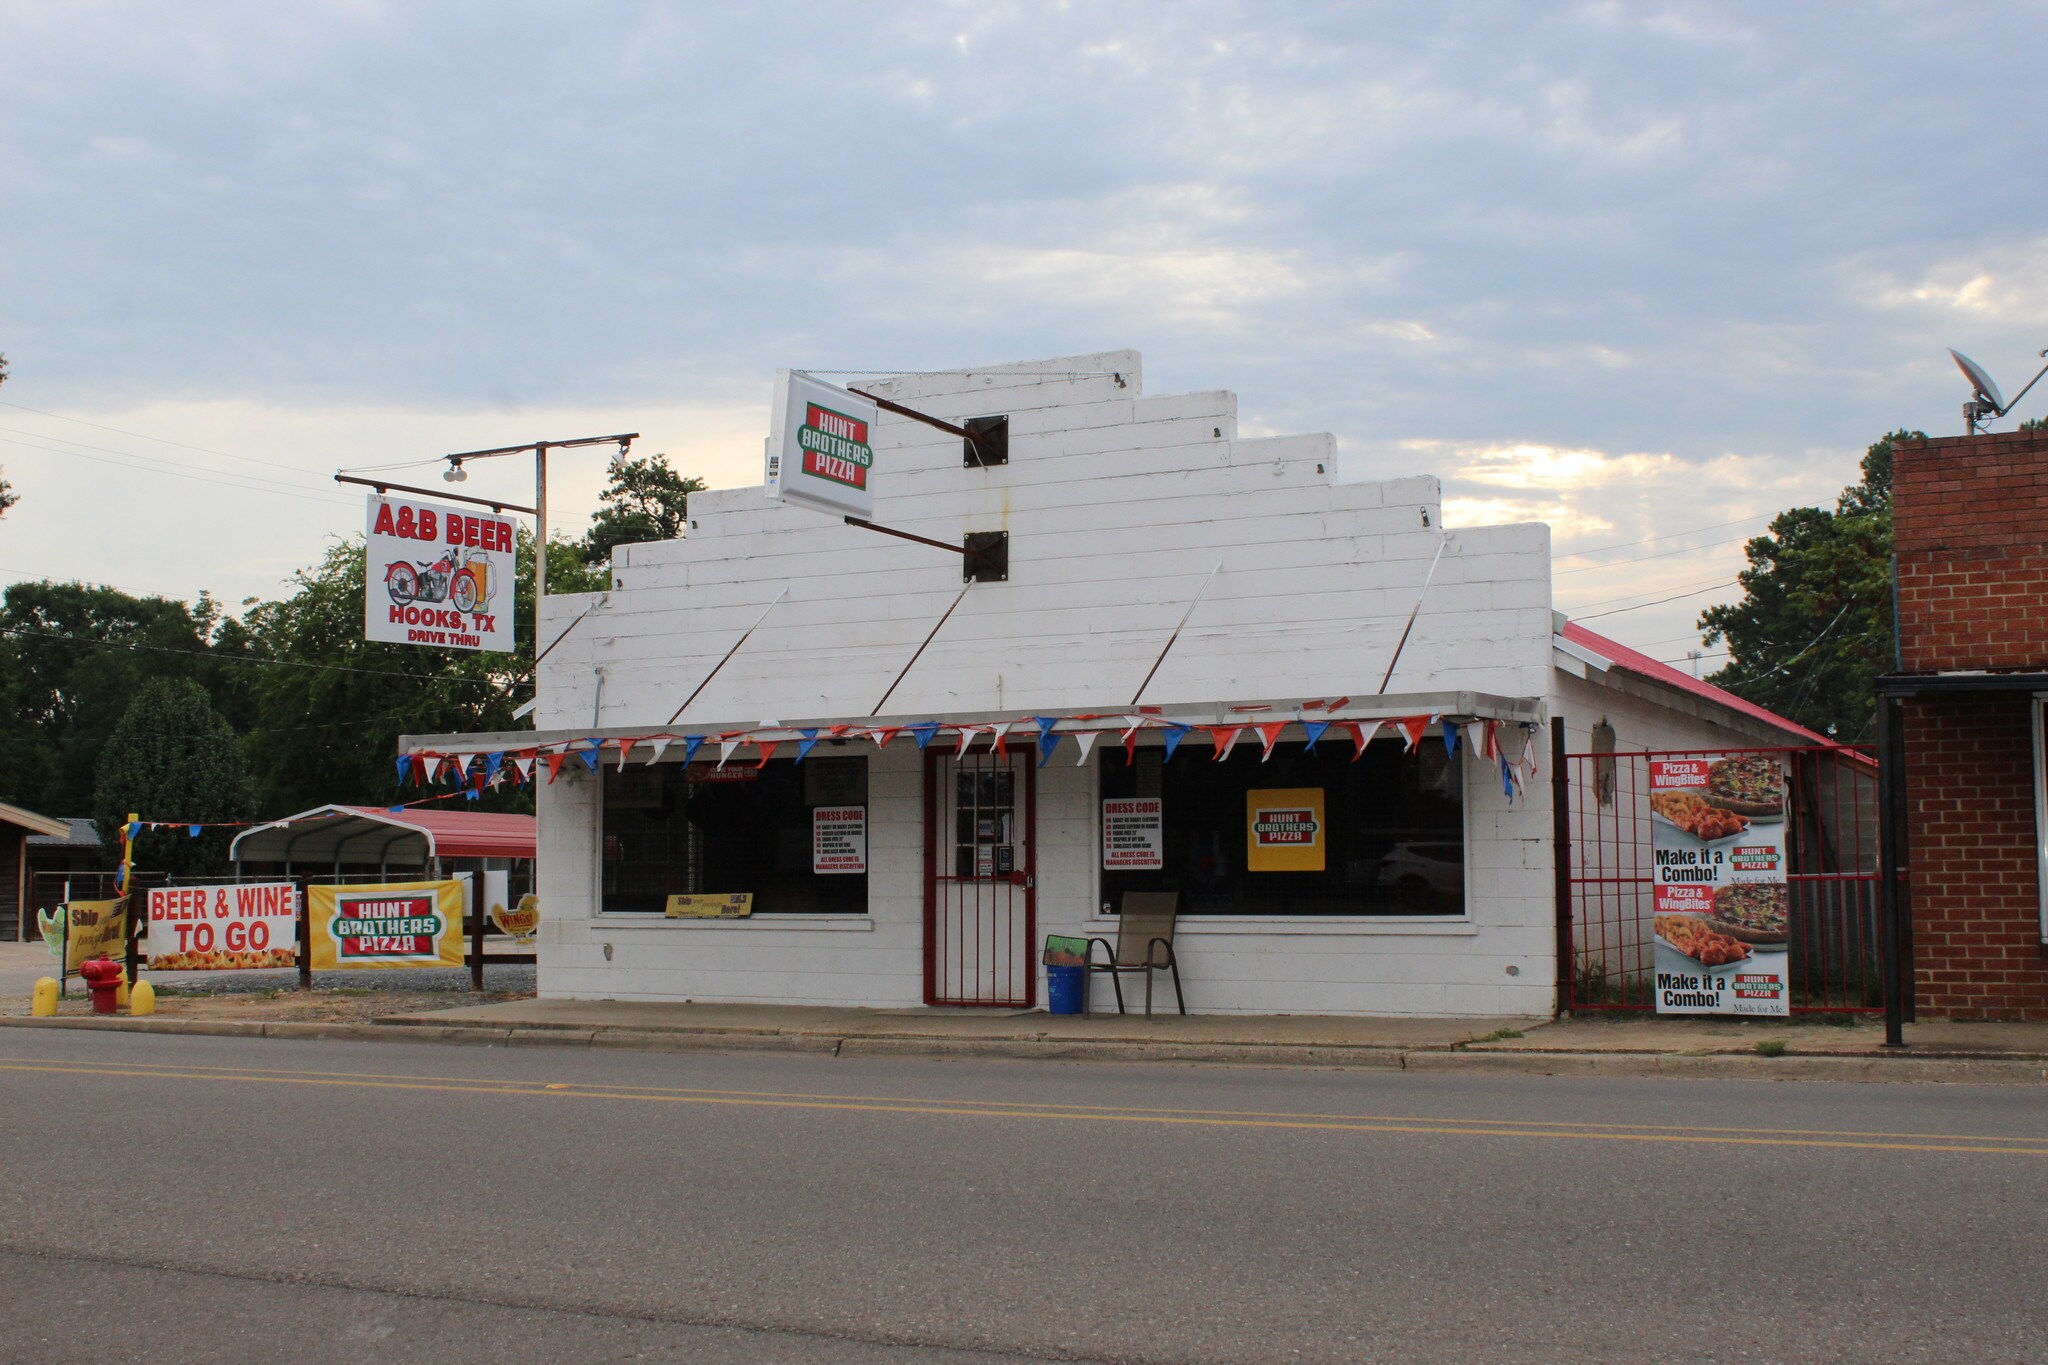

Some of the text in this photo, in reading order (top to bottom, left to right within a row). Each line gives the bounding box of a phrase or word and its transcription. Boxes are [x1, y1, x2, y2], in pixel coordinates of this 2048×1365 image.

[819, 412, 856, 441] HUNT
[802, 428, 868, 466] BROTHERS
[816, 453, 854, 481] PIZZA
[374, 503, 512, 553] A&B BEER
[389, 605, 495, 632] HOOKS, TX
[408, 629, 480, 647] DRIVE THRU
[1663, 763, 1698, 774] Pizza &
[816, 810, 863, 821] DRESS CODE
[1106, 802, 1160, 814] DRESS CODE
[1270, 814, 1300, 822] HUNT
[1258, 823, 1314, 832] BROTHERS
[1270, 832, 1302, 840] PIZZA
[1656, 849, 1723, 865] Make it a
[1662, 866, 1718, 882] Combo!
[1667, 886, 1703, 898] Pizza &
[152, 890, 206, 920] BEER
[214, 888, 230, 918] &
[236, 886, 292, 917] WINE
[678, 896, 692, 905] Ship
[358, 901, 412, 919] HUNT
[72, 910, 98, 927] Ship
[338, 918, 434, 935] BROTHERS
[174, 920, 269, 952] TO GO
[359, 935, 416, 951] PIZZA
[1658, 974, 1725, 990] Make it a
[1734, 982, 1781, 990] BROTHERS
[1664, 991, 1720, 1007] Combo!
[1734, 1004, 1755, 1013] Made
[1758, 1004, 1768, 1012] for
